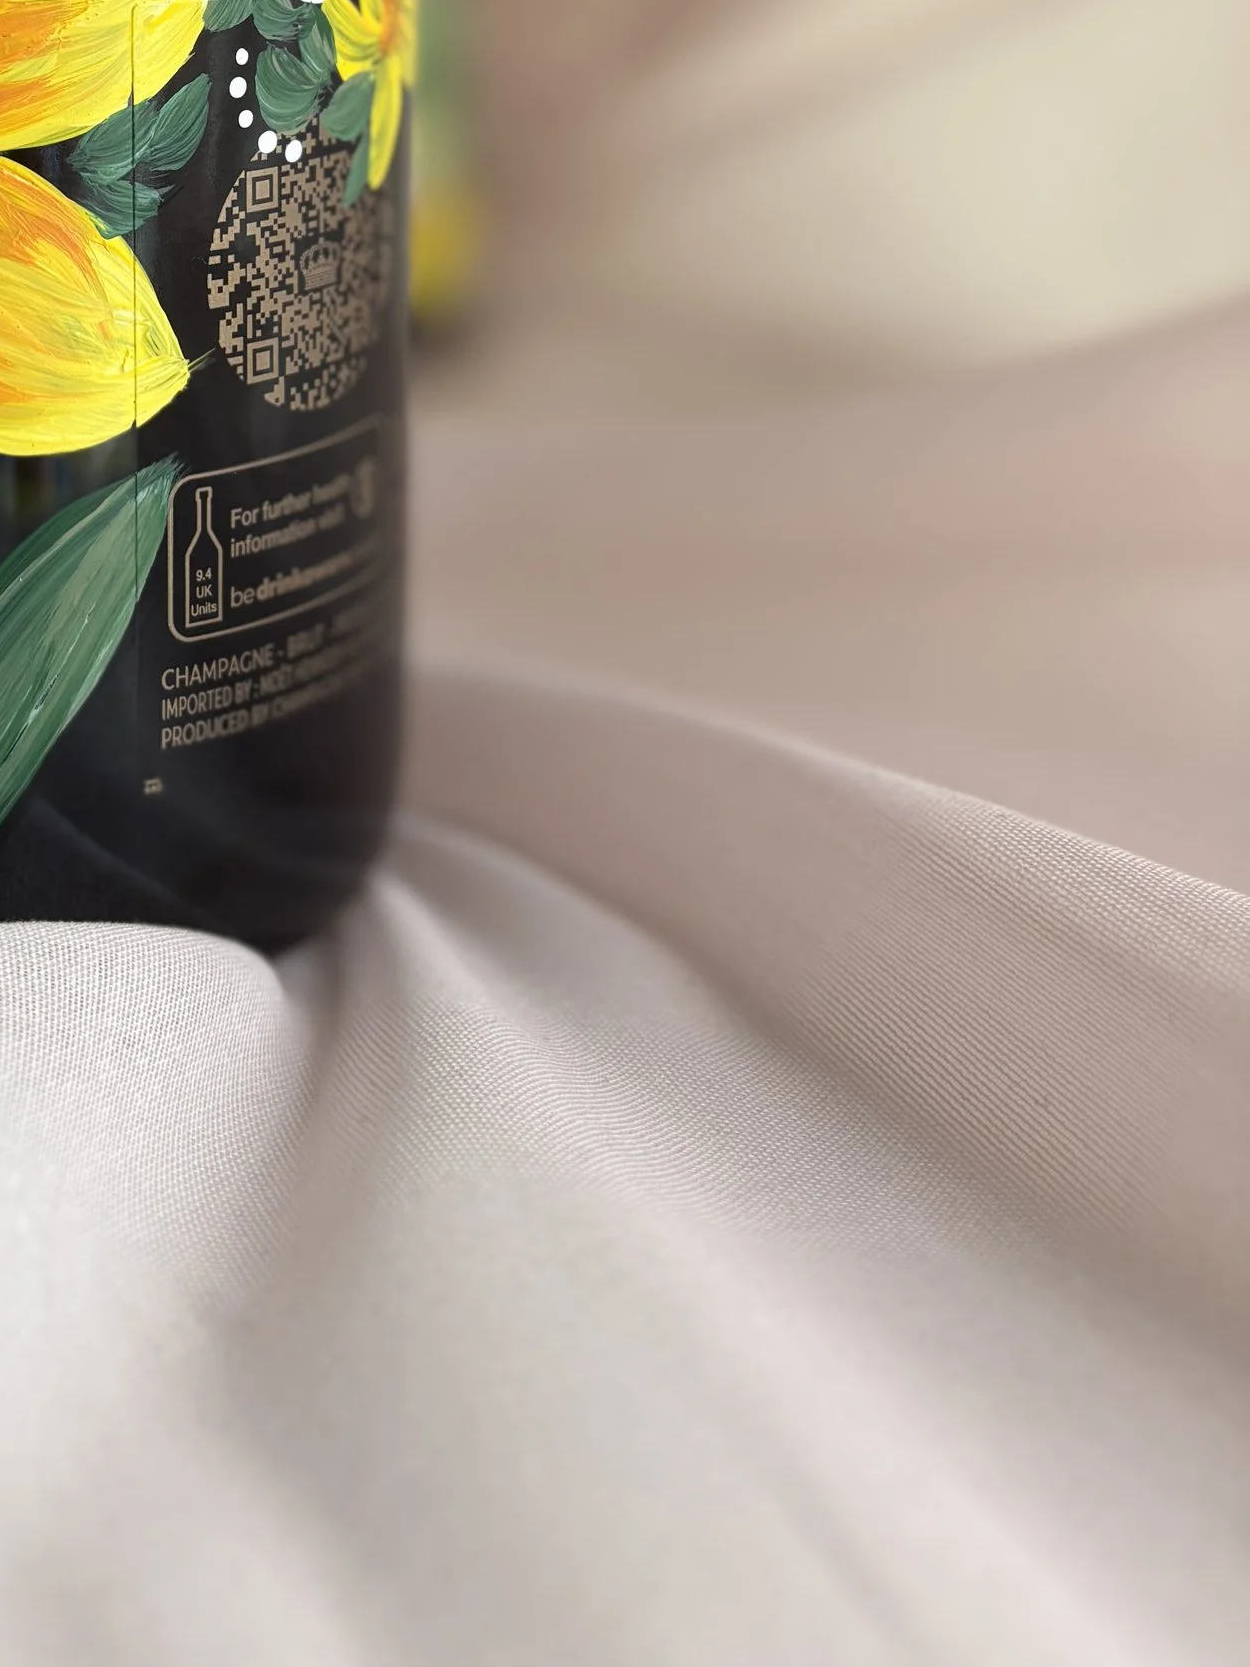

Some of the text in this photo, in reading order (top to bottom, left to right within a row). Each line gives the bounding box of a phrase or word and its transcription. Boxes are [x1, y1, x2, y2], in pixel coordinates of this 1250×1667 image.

[230, 507, 258, 530] For
[195, 567, 212, 582] 9.4
[196, 585, 213, 599] UK
[190, 601, 218, 617] Units
[161, 642, 275, 691] CHAMPAGNE
[161, 684, 233, 721] IMPORTED
[161, 708, 249, 750] PRODUCED
